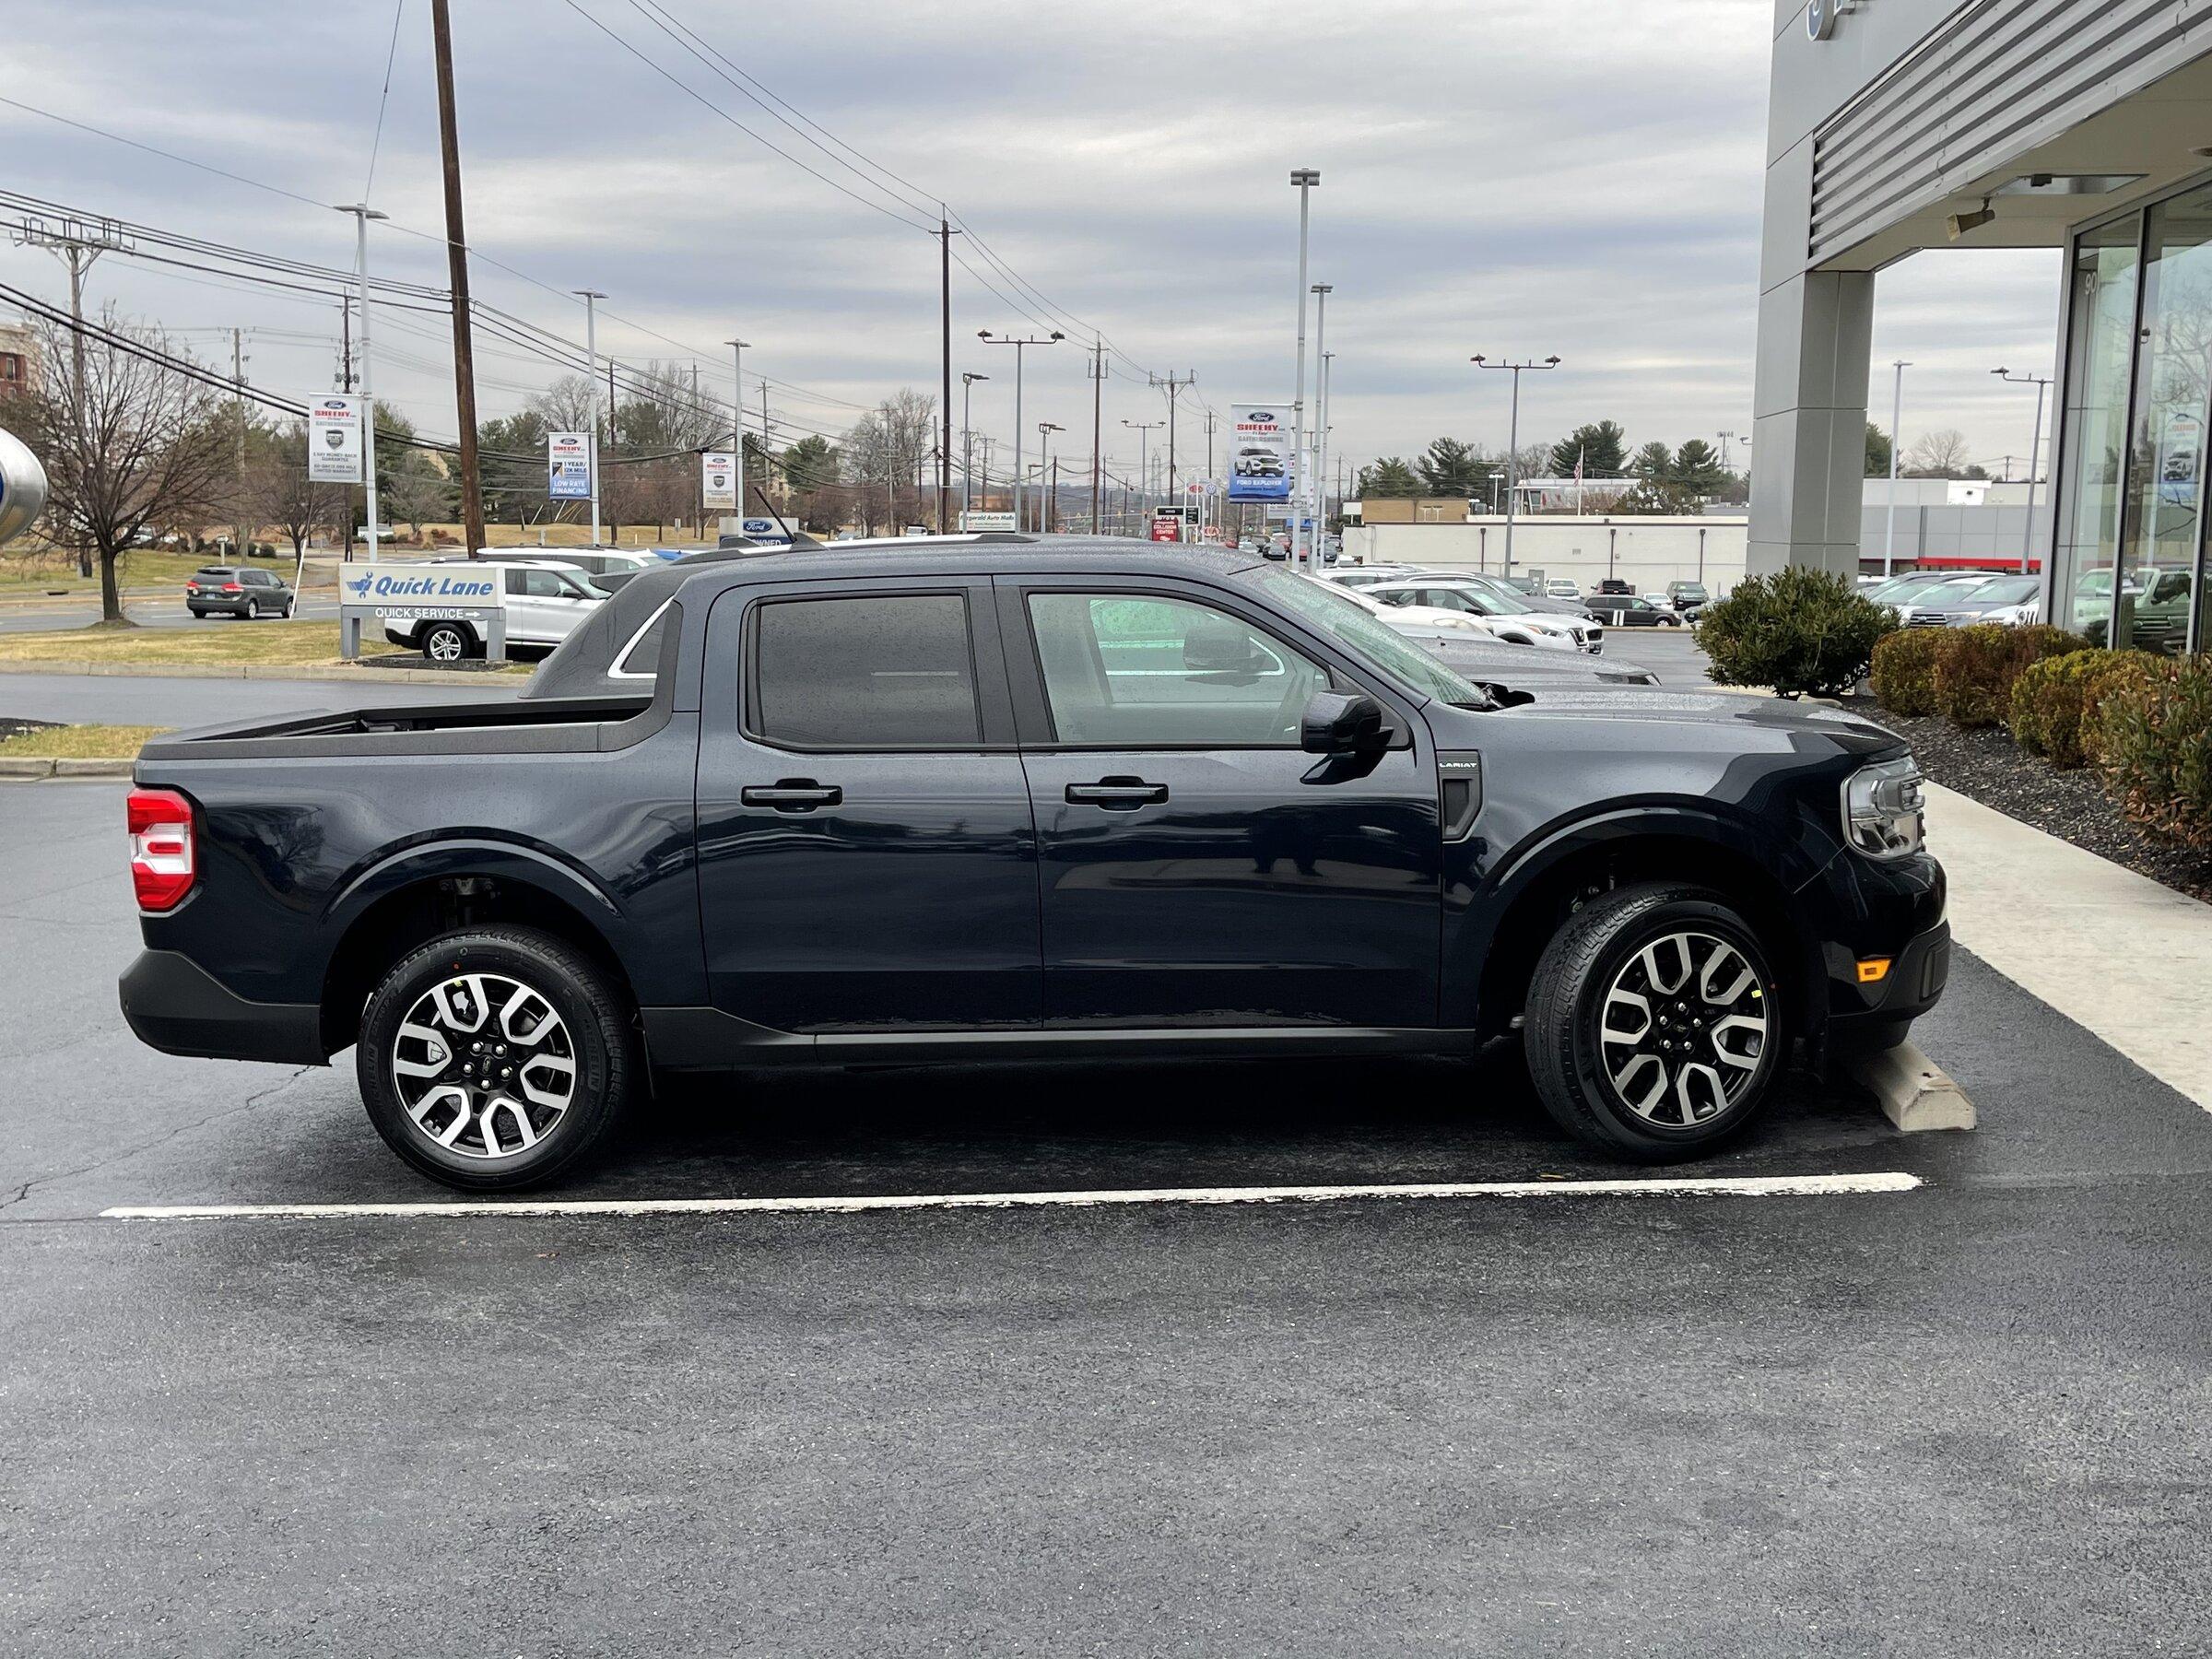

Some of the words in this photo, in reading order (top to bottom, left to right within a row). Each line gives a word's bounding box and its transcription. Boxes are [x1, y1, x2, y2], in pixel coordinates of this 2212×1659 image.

[1252, 413, 1271, 421] Ford
[745, 521, 767, 532] Ford
[375, 576, 438, 596] Quick
[439, 577, 493, 595] Lane
[375, 607, 412, 618] QUICK
[414, 607, 464, 618] SERVICE
